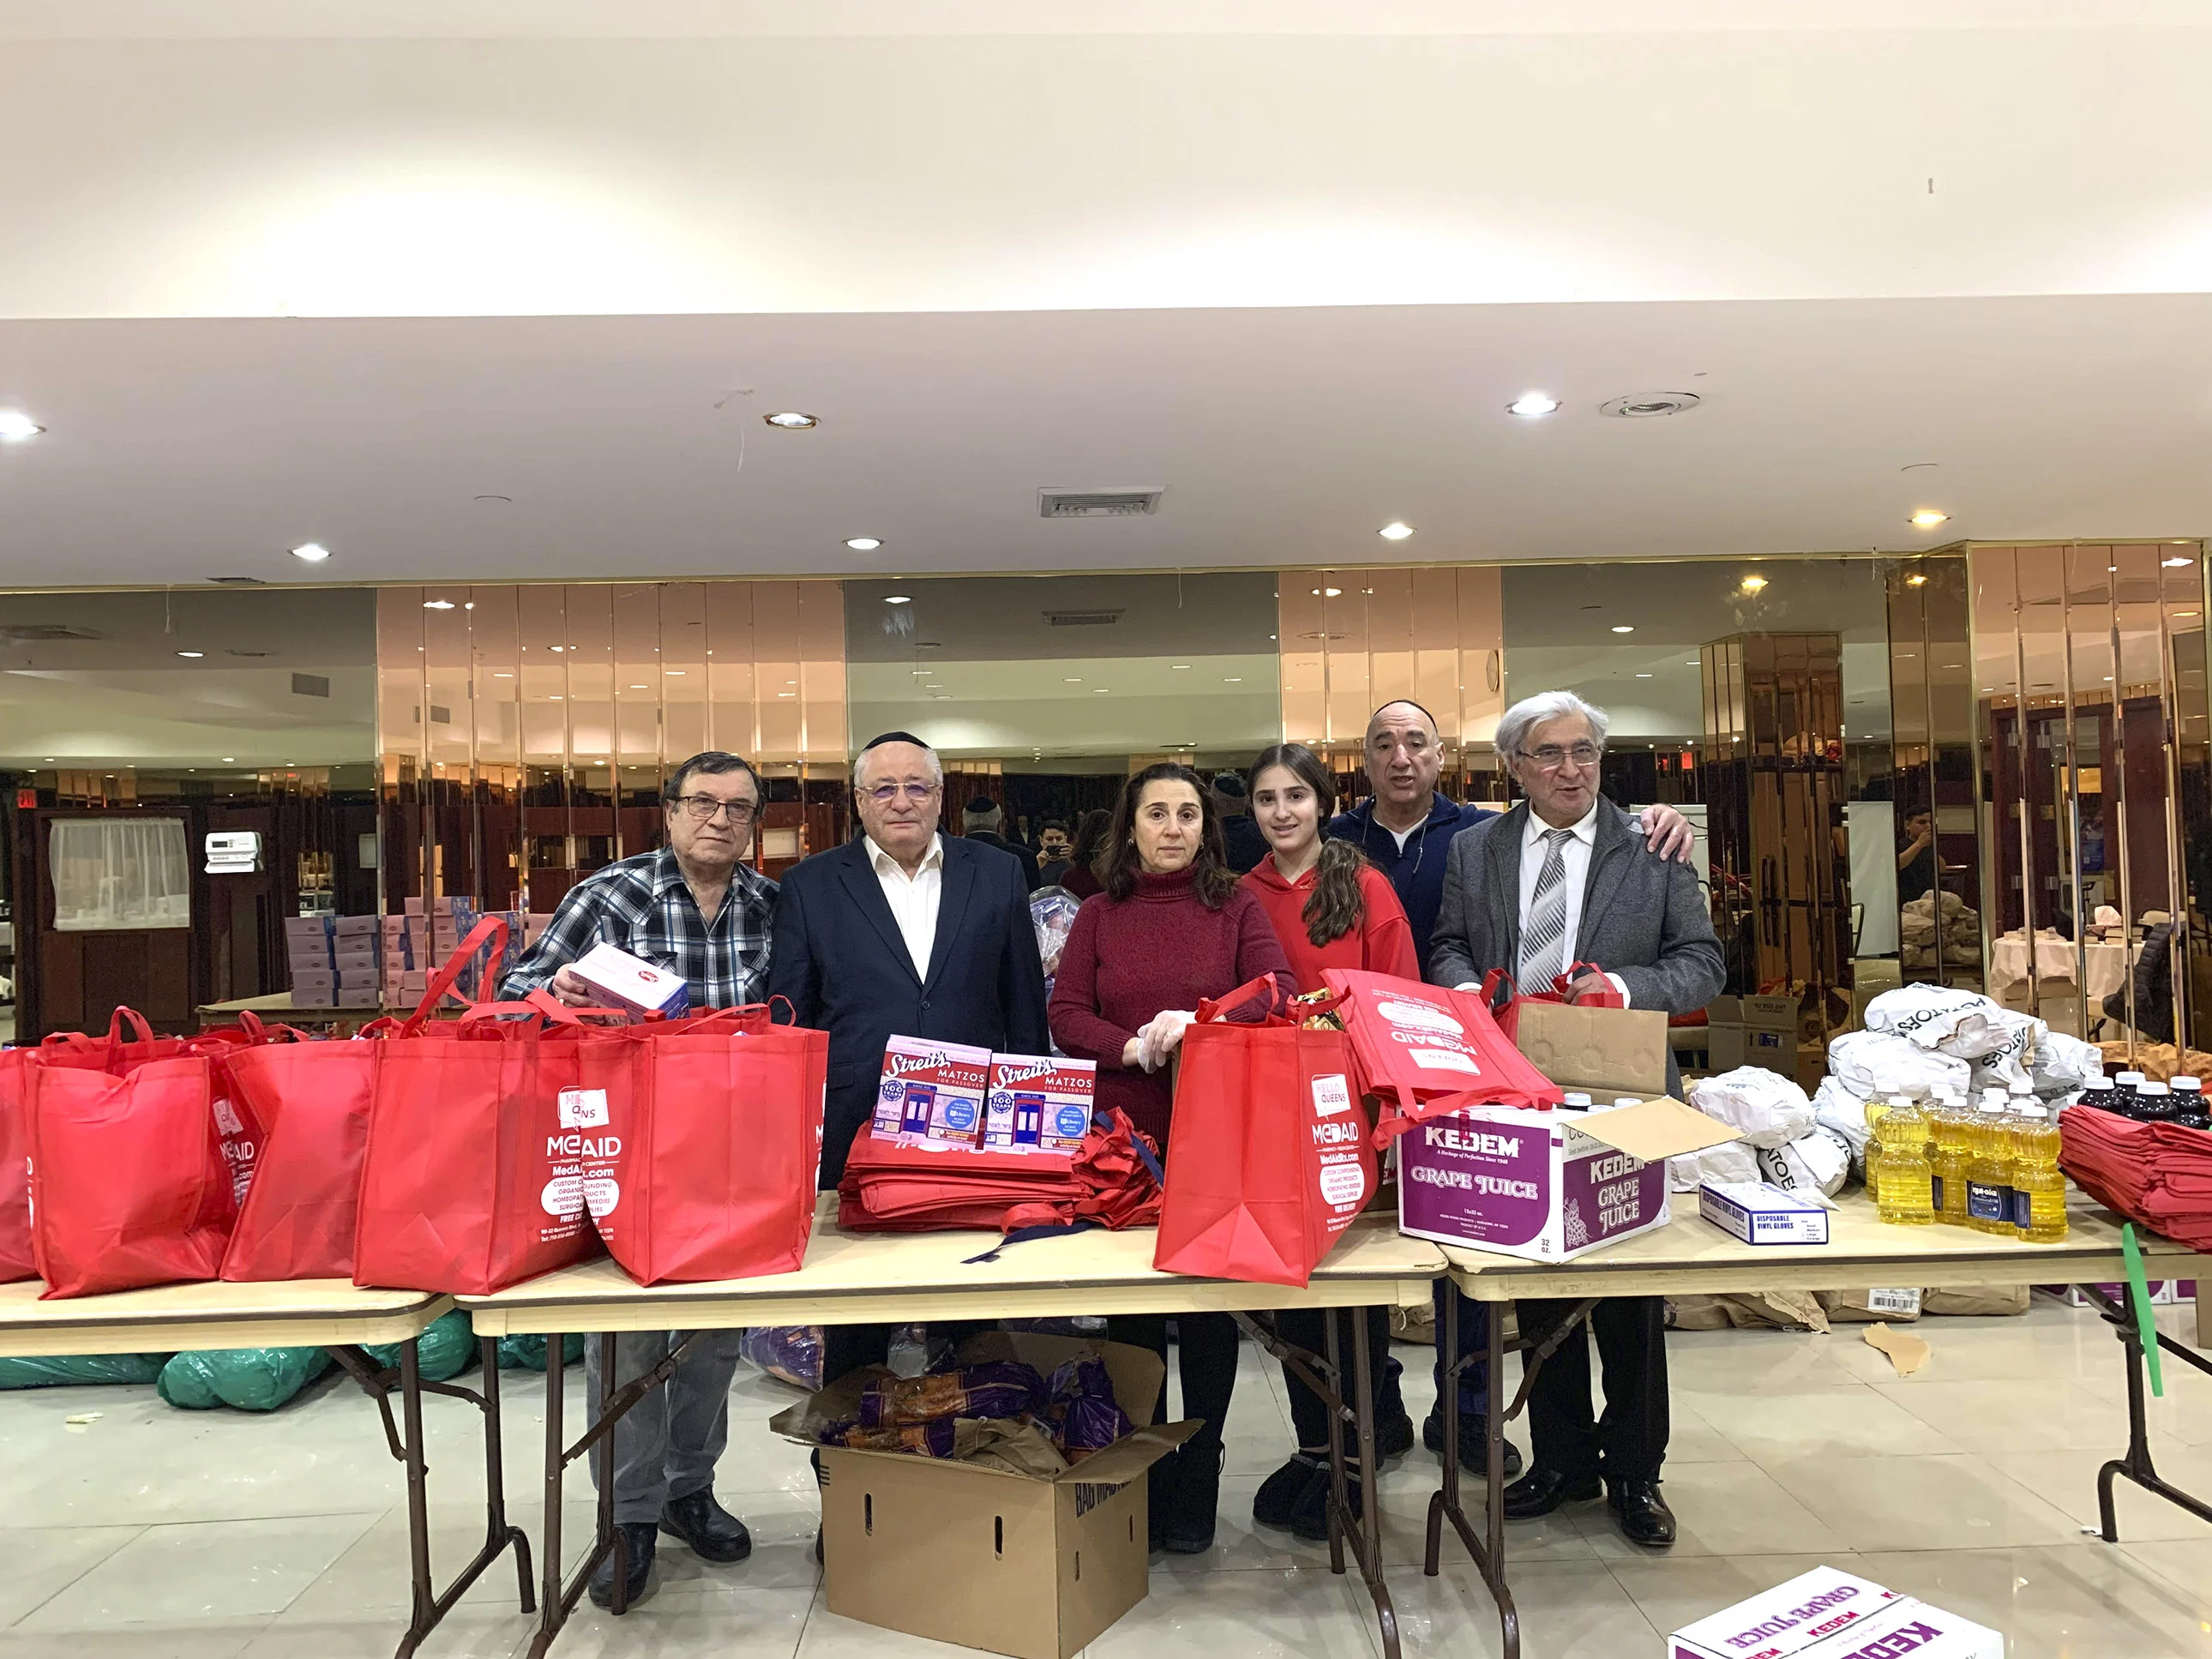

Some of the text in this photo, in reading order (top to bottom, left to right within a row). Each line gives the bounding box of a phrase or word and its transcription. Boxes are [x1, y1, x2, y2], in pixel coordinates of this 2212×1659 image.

[885, 1050, 951, 1078] Streit's
[937, 1069, 985, 1083] MATZOS
[992, 1060, 1058, 1090] Streit's
[1044, 1077, 1092, 1088] MATZOS
[884, 1085, 903, 1093] 100
[951, 1079, 983, 1088] PASSOVER
[1316, 1083, 1339, 1093] HELLO
[1321, 1093, 1346, 1103] QUEENS
[1425, 1126, 1519, 1158] KEDEM
[1441, 1150, 1458, 1158] Heritage
[1410, 1166, 1473, 1190] GRAPE
[1474, 1175, 1539, 1200] JUICE
[552, 1194, 583, 1204] HOMEOPAT
[1598, 1177, 1639, 1209] GRAPE
[559, 1202, 583, 1211] SURGICA
[560, 1214, 574, 1223] FREE
[1599, 1199, 1639, 1235] JUICE
[1732, 1206, 1745, 1223] GLOVES
[1788, 1586, 1860, 1620] GRAPE
[1806, 1610, 1860, 1638] KEDEM
[1723, 1615, 1800, 1649] JUICE
